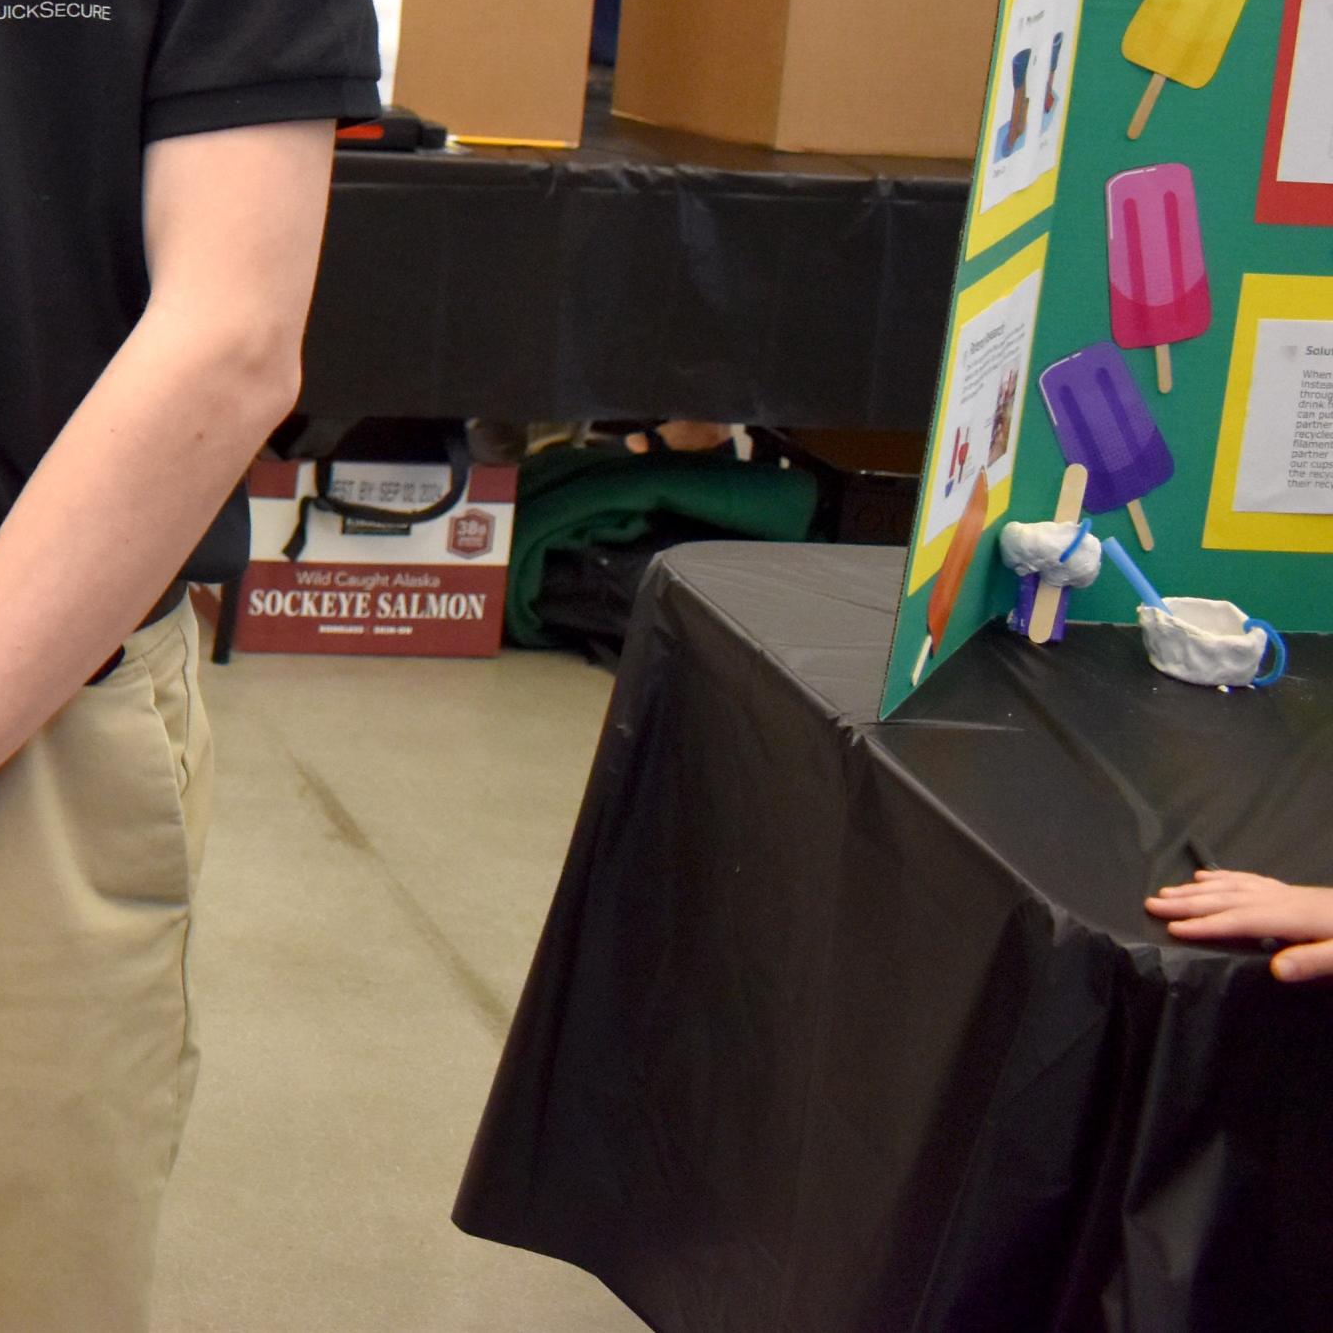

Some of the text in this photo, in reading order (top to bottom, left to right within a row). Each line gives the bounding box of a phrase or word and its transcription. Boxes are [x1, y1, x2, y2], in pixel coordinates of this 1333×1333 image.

[297, 570, 442, 591] Wild Caught Alaska
[249, 587, 486, 619] SOCKEYE SALMON
